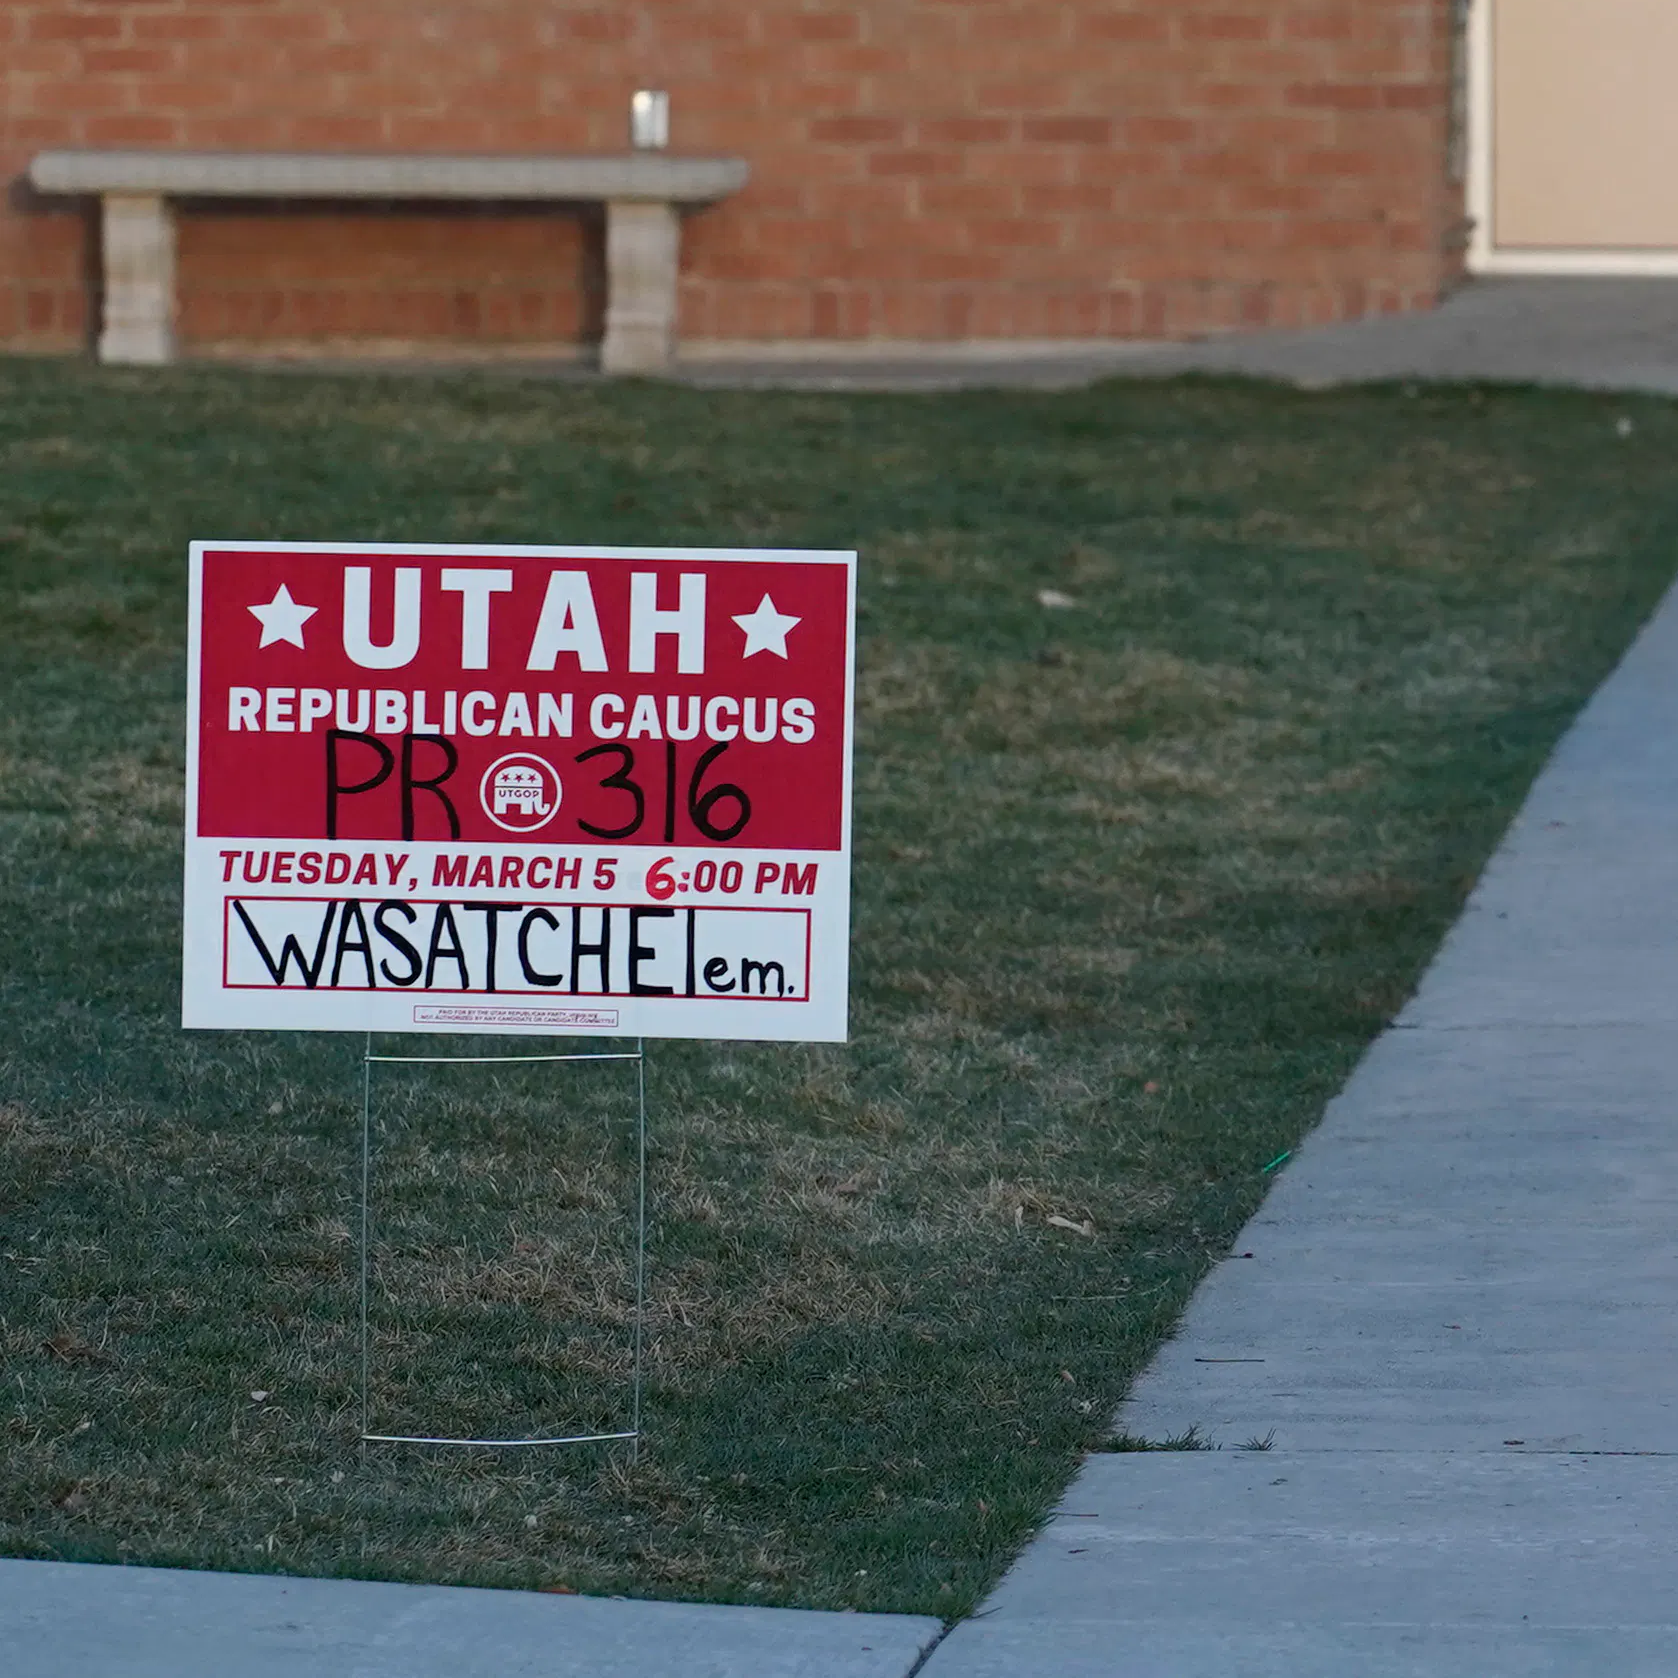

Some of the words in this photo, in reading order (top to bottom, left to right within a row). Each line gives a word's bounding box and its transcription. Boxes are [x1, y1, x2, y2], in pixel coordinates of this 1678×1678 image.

[340, 565, 708, 675] UTAH
[227, 686, 573, 738] REPUBLICAN
[589, 693, 817, 744] CAUCUS
[325, 729, 462, 841] PR
[575, 740, 752, 844] 316
[498, 789, 540, 798] UTGOP
[218, 850, 419, 891] TUESDAY,
[431, 855, 583, 891] MARCH
[593, 858, 618, 891] 5
[644, 856, 744, 899] 6:00
[755, 861, 819, 896] PM
